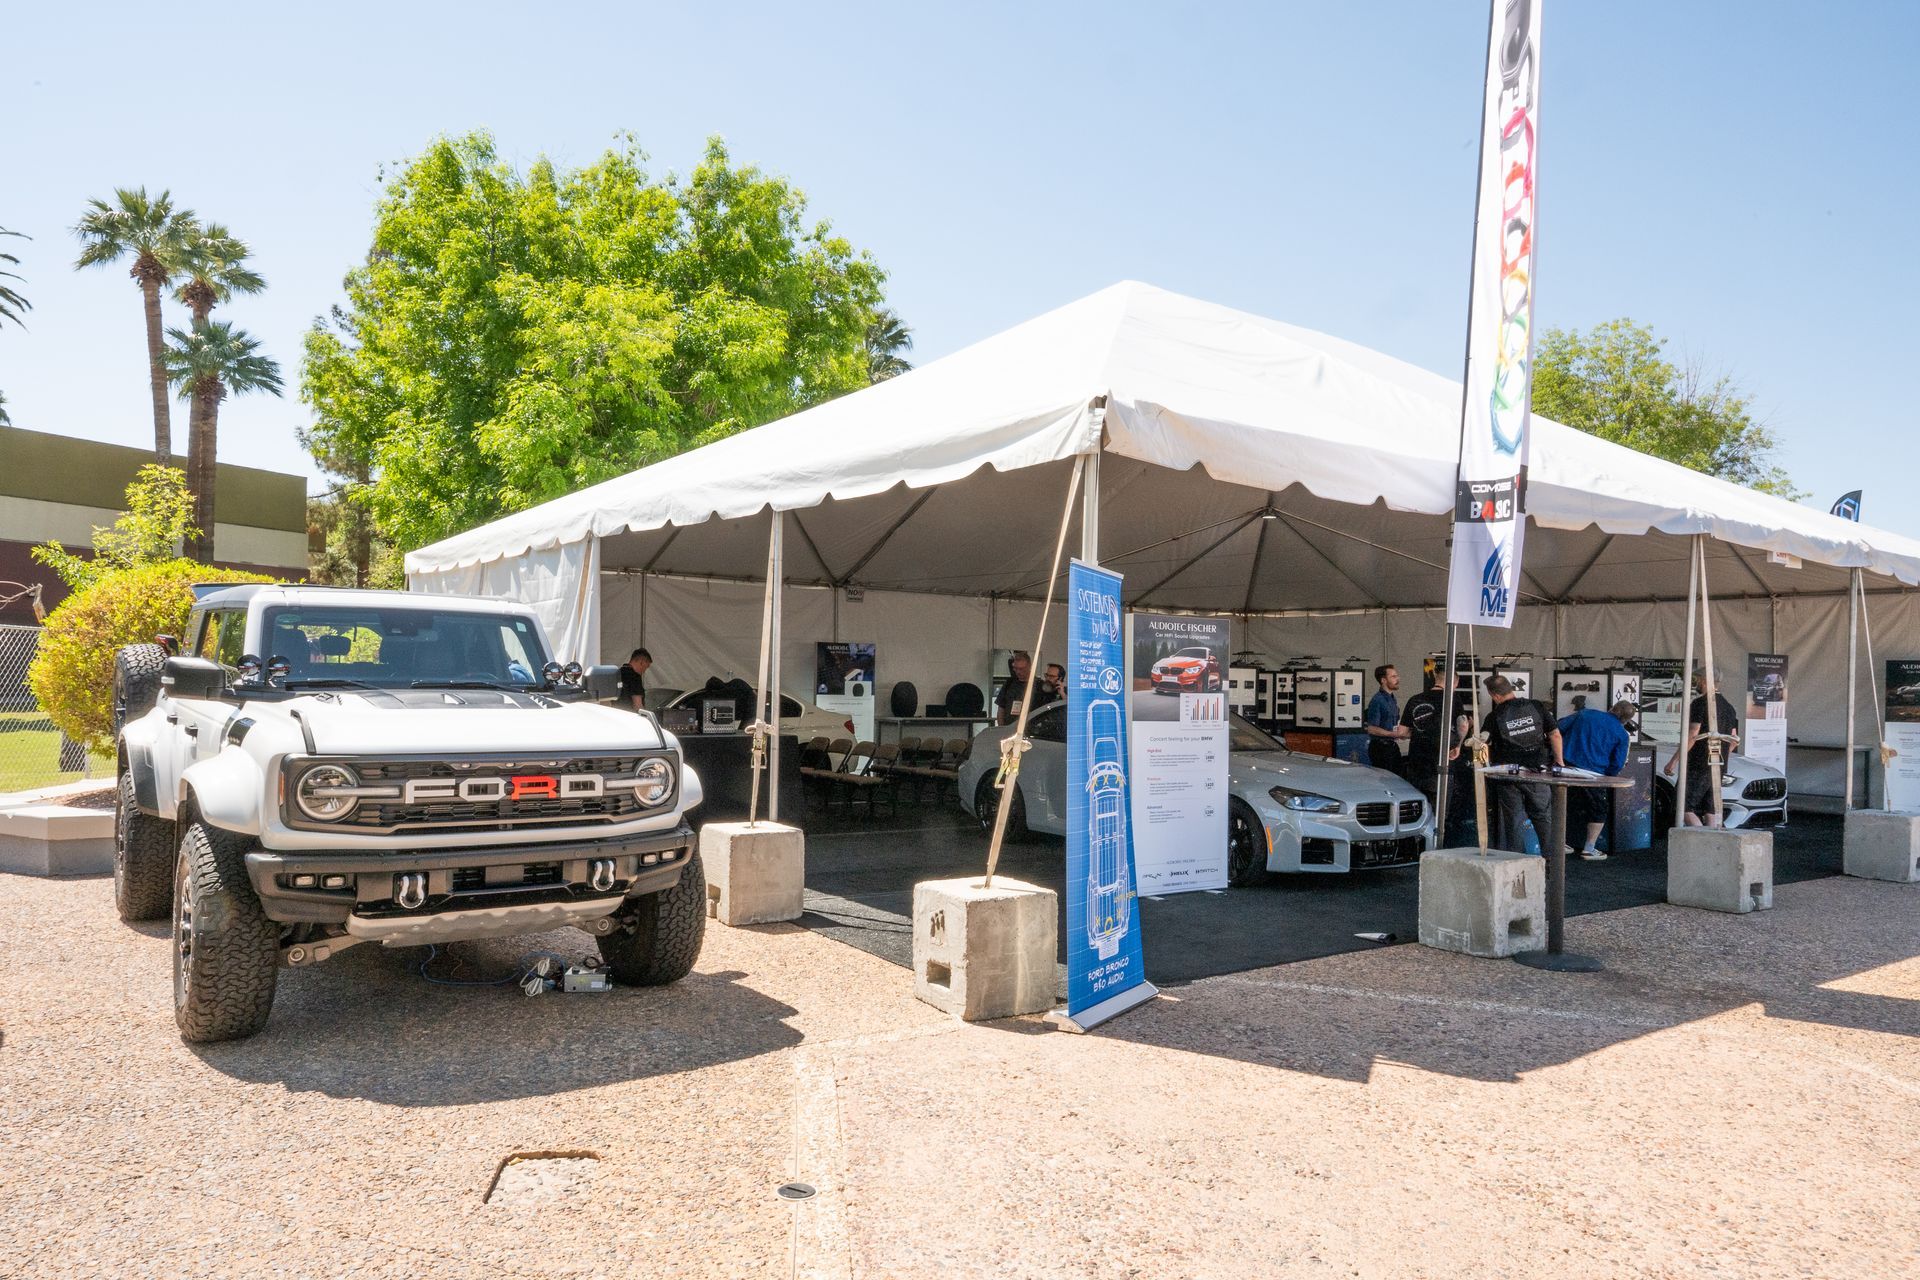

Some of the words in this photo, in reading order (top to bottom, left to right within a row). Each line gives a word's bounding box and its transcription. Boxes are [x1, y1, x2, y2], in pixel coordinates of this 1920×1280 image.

[1092, 618, 1100, 638] by
[1149, 621, 1186, 632] AUDIOTEC
[1187, 624, 1217, 633] FISCHER
[1104, 669, 1119, 691] Ford
[1506, 717, 1534, 729] EXPO
[405, 774, 604, 804] FORD
[1088, 967, 1104, 981] FORD
[1105, 957, 1129, 975] BRONCO
[1107, 971, 1124, 987] AUDIO
